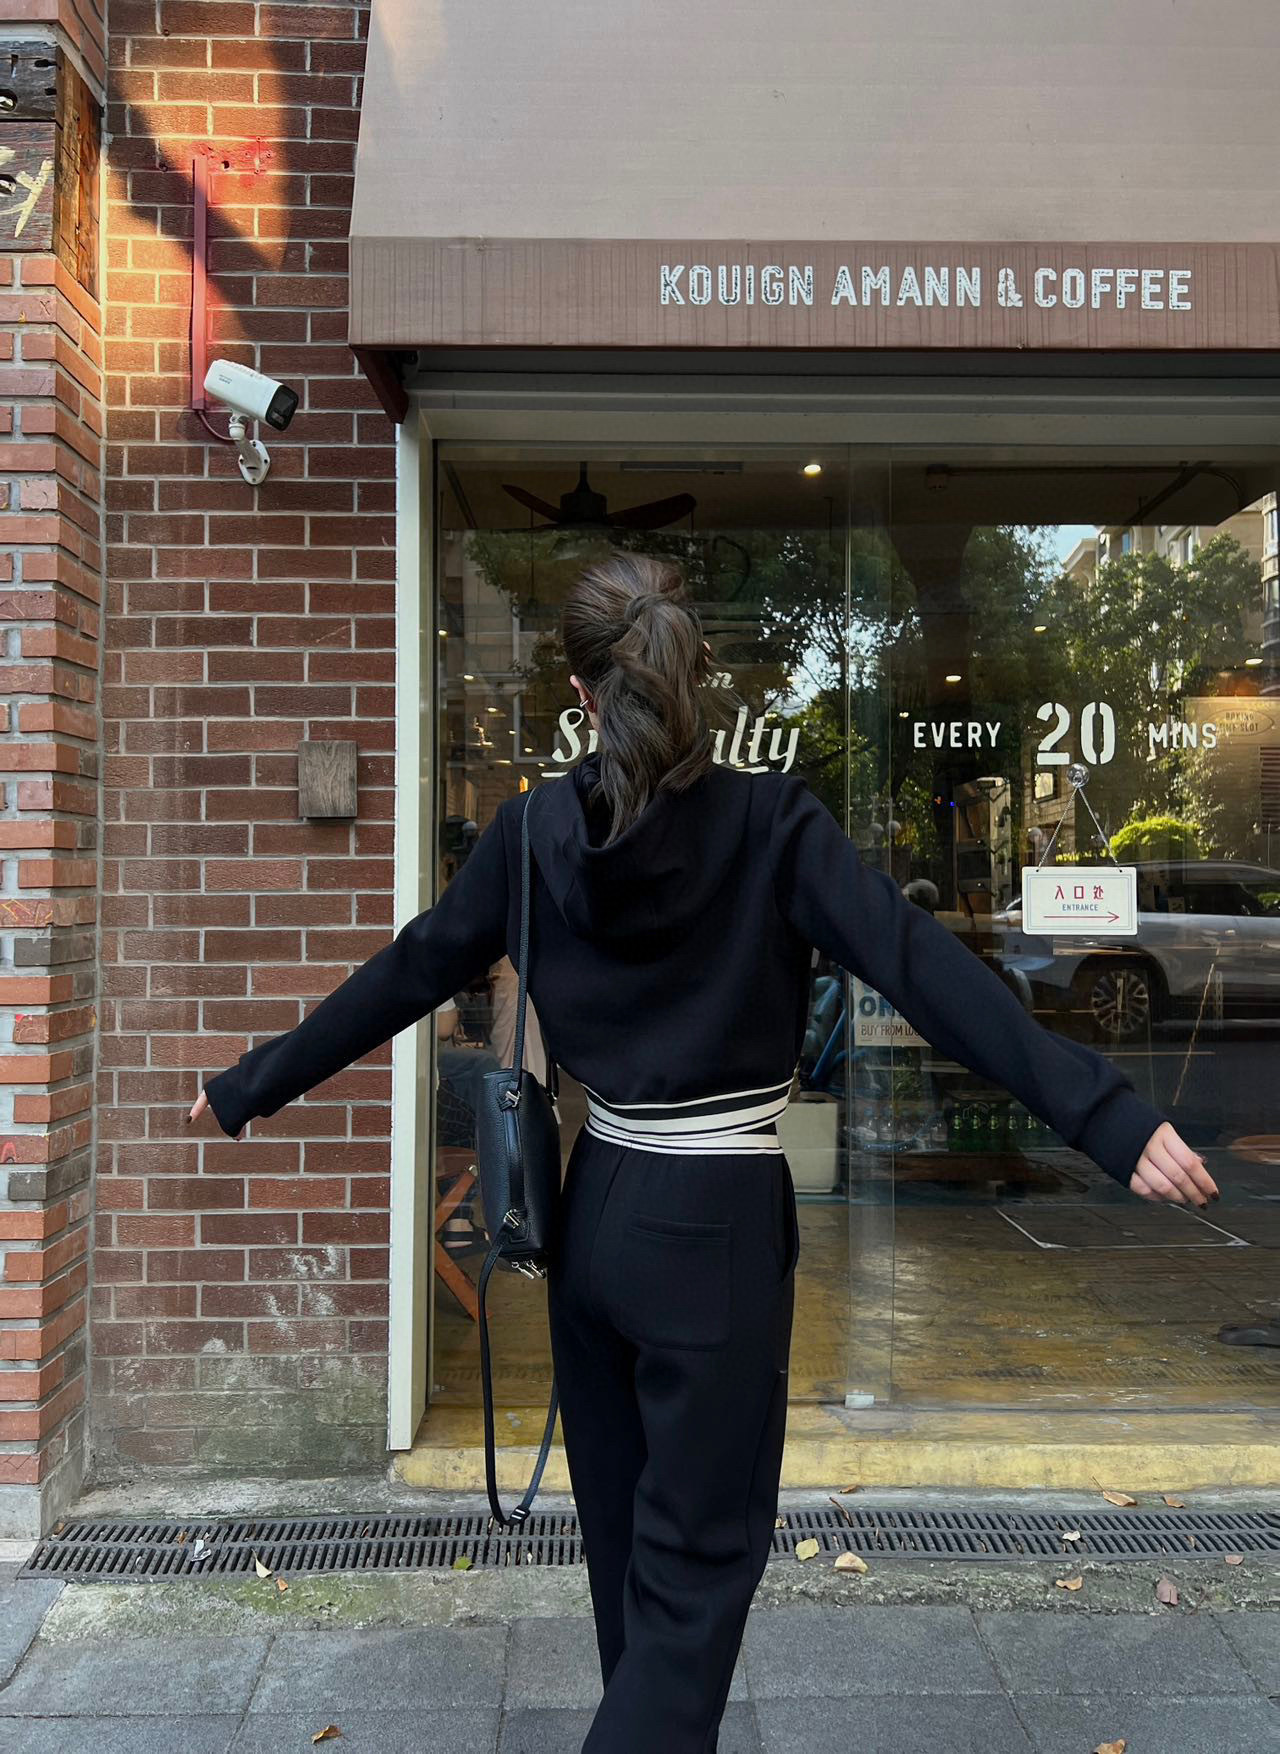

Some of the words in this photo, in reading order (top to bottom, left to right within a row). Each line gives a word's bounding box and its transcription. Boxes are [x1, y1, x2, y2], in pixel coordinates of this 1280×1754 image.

[660, 265, 814, 305] KOUIGN
[830, 266, 981, 307] AMANN
[998, 267, 1023, 307] &
[1034, 267, 1192, 310] COFFEE
[913, 721, 1001, 748] EVERY
[1036, 701, 1116, 766] 20
[1148, 722, 1218, 750] MINS
[1240, 722, 1259, 732] SLOT
[1055, 885, 1104, 900] 入口处
[1062, 903, 1099, 912] ENTRANCE
[861, 1024, 879, 1036] BUY
[880, 1024, 903, 1036] FROM
